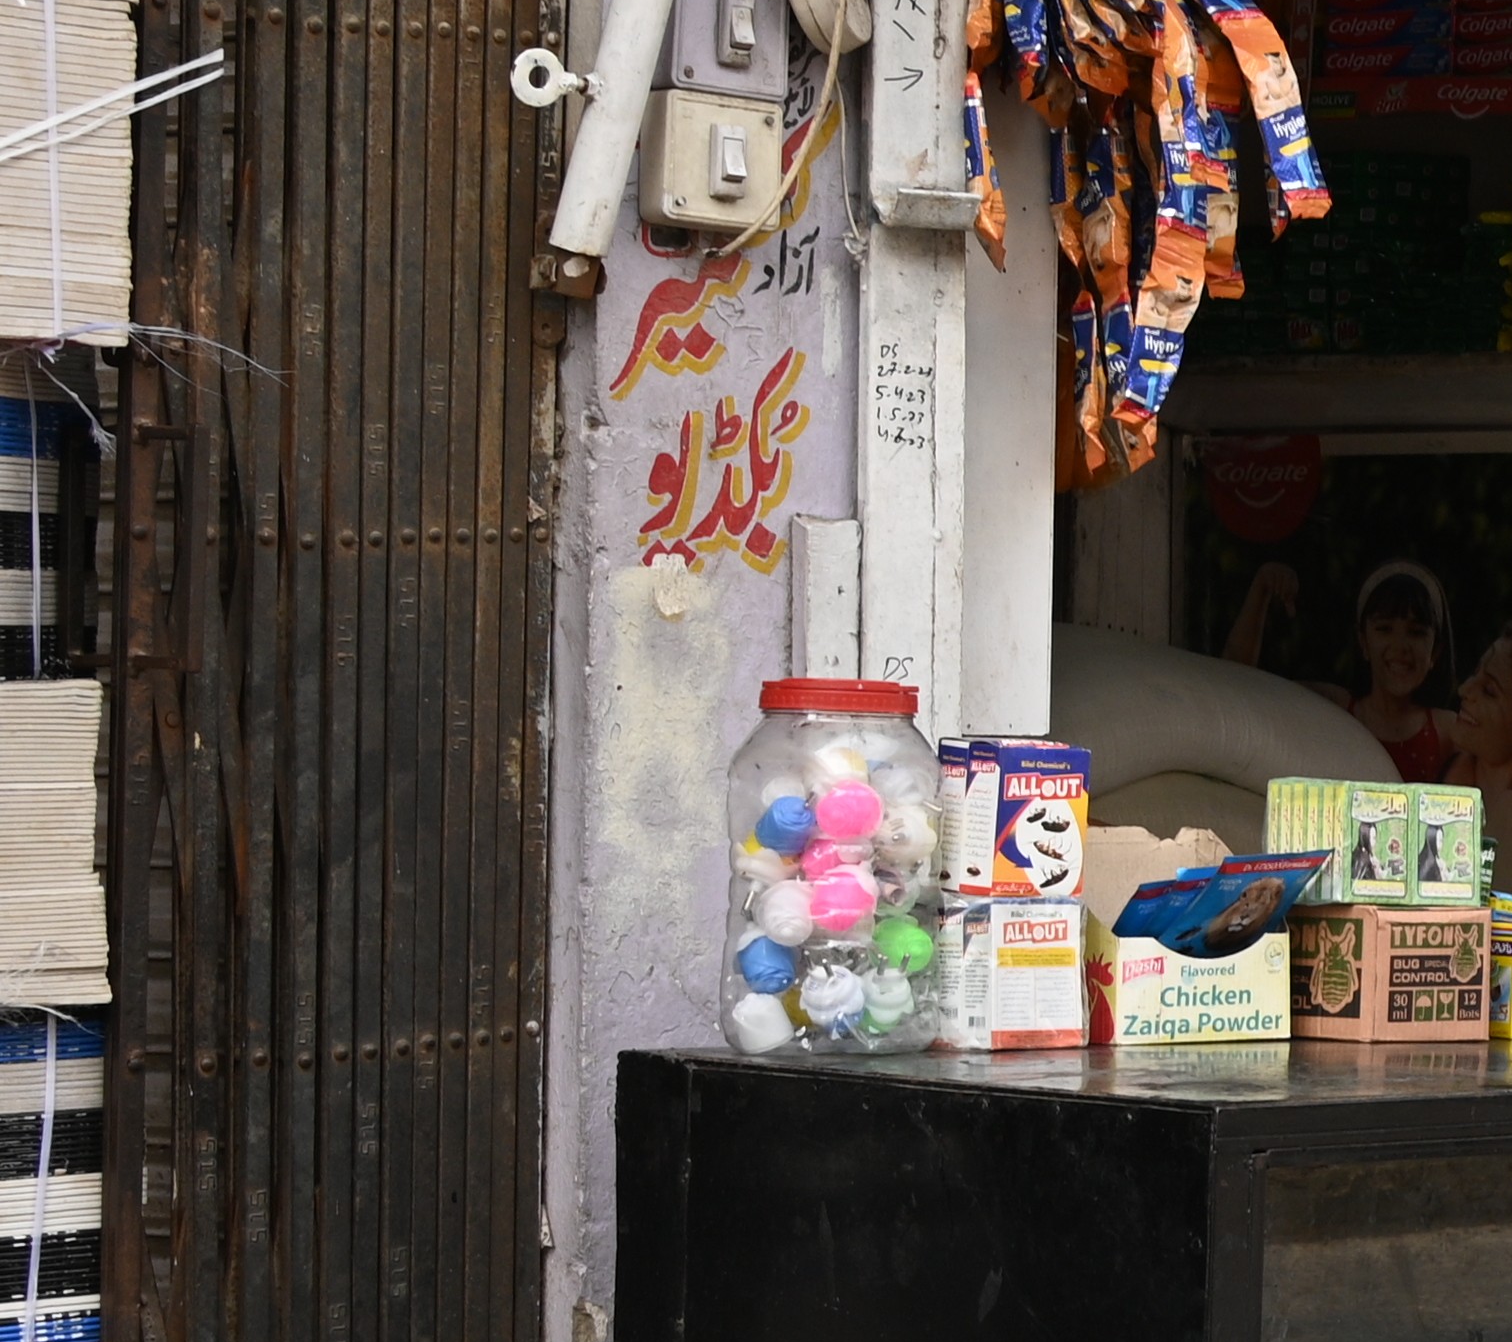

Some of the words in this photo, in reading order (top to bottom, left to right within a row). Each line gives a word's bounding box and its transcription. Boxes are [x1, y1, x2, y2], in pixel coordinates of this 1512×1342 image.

[1391, 925, 1453, 947] TYFON
[1180, 963, 1236, 978] Flavored
[1392, 971, 1450, 984] CONTROL
[1160, 986, 1251, 1007] Chicken
[1393, 992, 1408, 1007] 30
[1462, 993, 1478, 1006] 12
[1122, 1013, 1190, 1040] Zaiqa
[1198, 1011, 1283, 1035] Powder
